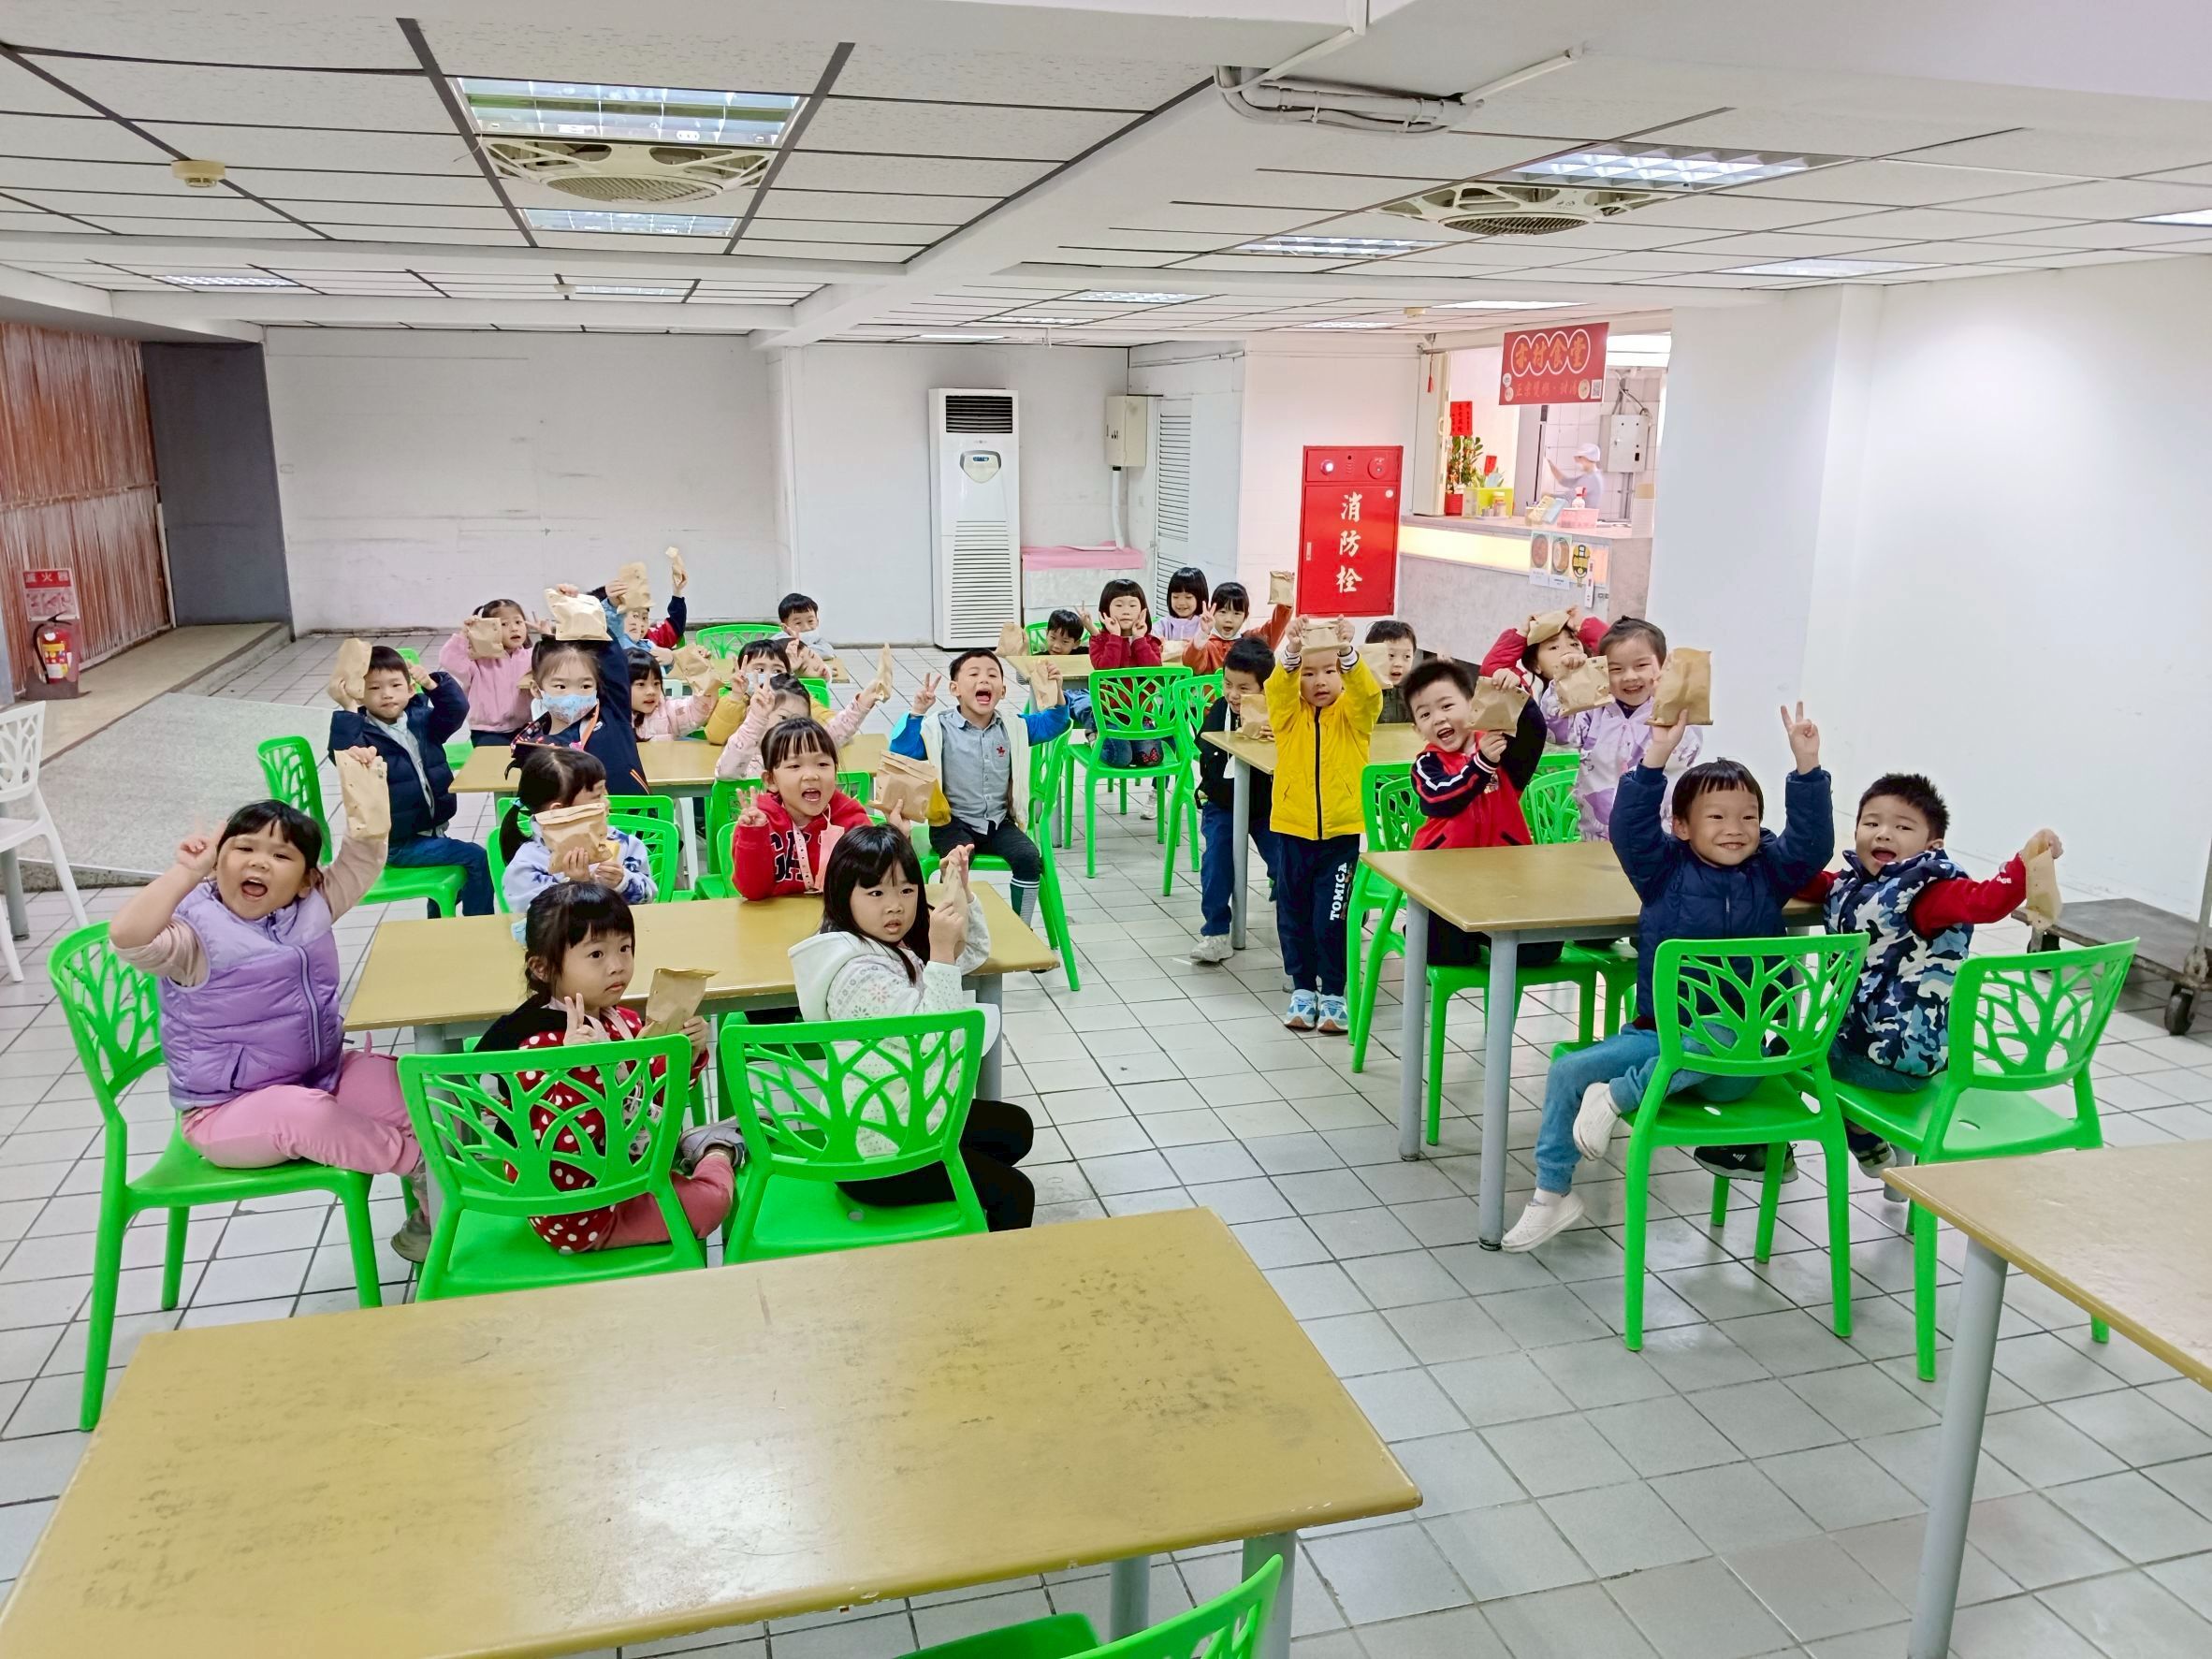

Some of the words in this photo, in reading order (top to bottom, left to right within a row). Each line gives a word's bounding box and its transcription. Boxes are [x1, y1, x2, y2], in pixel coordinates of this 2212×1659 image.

[1336, 491, 1362, 593] 消防栓
[1330, 862, 1347, 921] TOMICA
